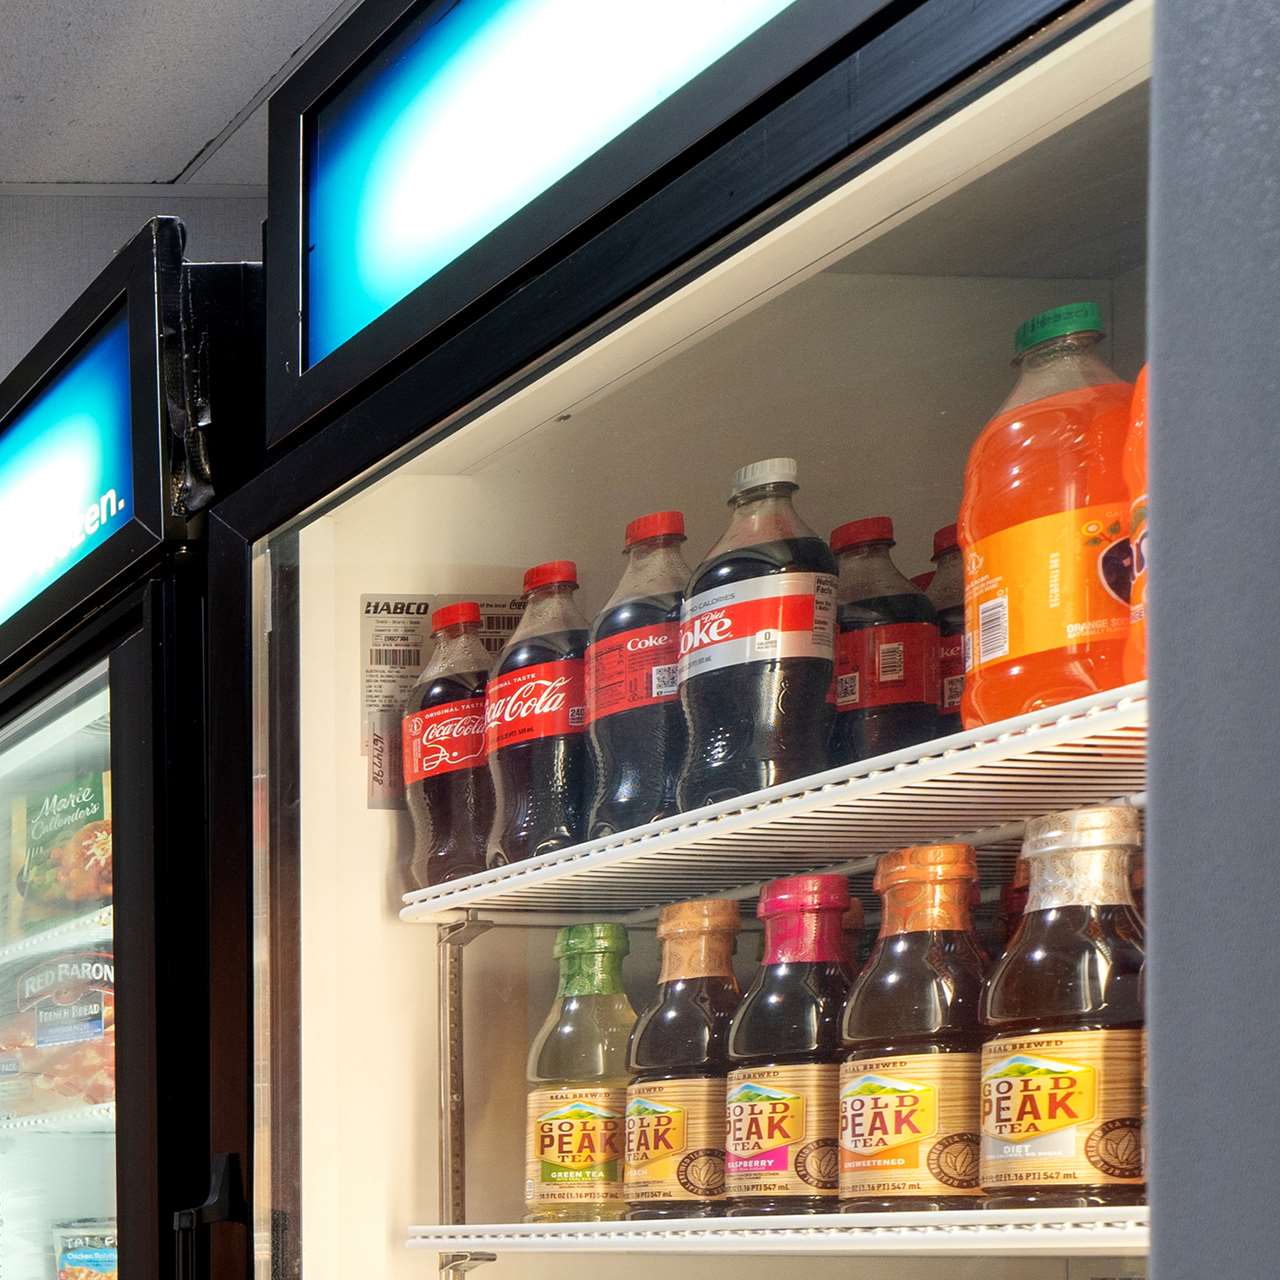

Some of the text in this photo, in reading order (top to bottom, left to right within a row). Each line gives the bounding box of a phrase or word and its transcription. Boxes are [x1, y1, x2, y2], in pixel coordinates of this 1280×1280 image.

[698, 593, 735, 611] CALORIES
[365, 602, 429, 615] HABCO
[702, 610, 725, 622] Diet
[627, 634, 669, 651] Coke
[513, 673, 536, 682] TASTE
[425, 707, 459, 719] ORIGINAL
[32, 787, 93, 823] Marie
[32, 802, 100, 840] Callender's
[25, 963, 114, 998] RED BARON
[72, 1004, 99, 1018] BREAD
[1011, 1040, 1063, 1052] BREWED
[863, 1061, 907, 1070] BREWED
[743, 1071, 780, 1079] BREWED
[982, 1077, 1078, 1096] GOLD
[841, 1095, 920, 1114] GOLD
[982, 1091, 1079, 1128] PEAK
[541, 1121, 618, 1133] GOLD
[840, 1108, 920, 1140] PEAK
[995, 1123, 1040, 1134] TEA
[541, 1133, 619, 1155] PEAK
[732, 1141, 762, 1151] TEA
[851, 1137, 888, 1148] TEA
[1003, 1144, 1031, 1154] DIET
[1042, 1172, 1078, 1180] 547 mL
[891, 1182, 921, 1191] 547 mL
